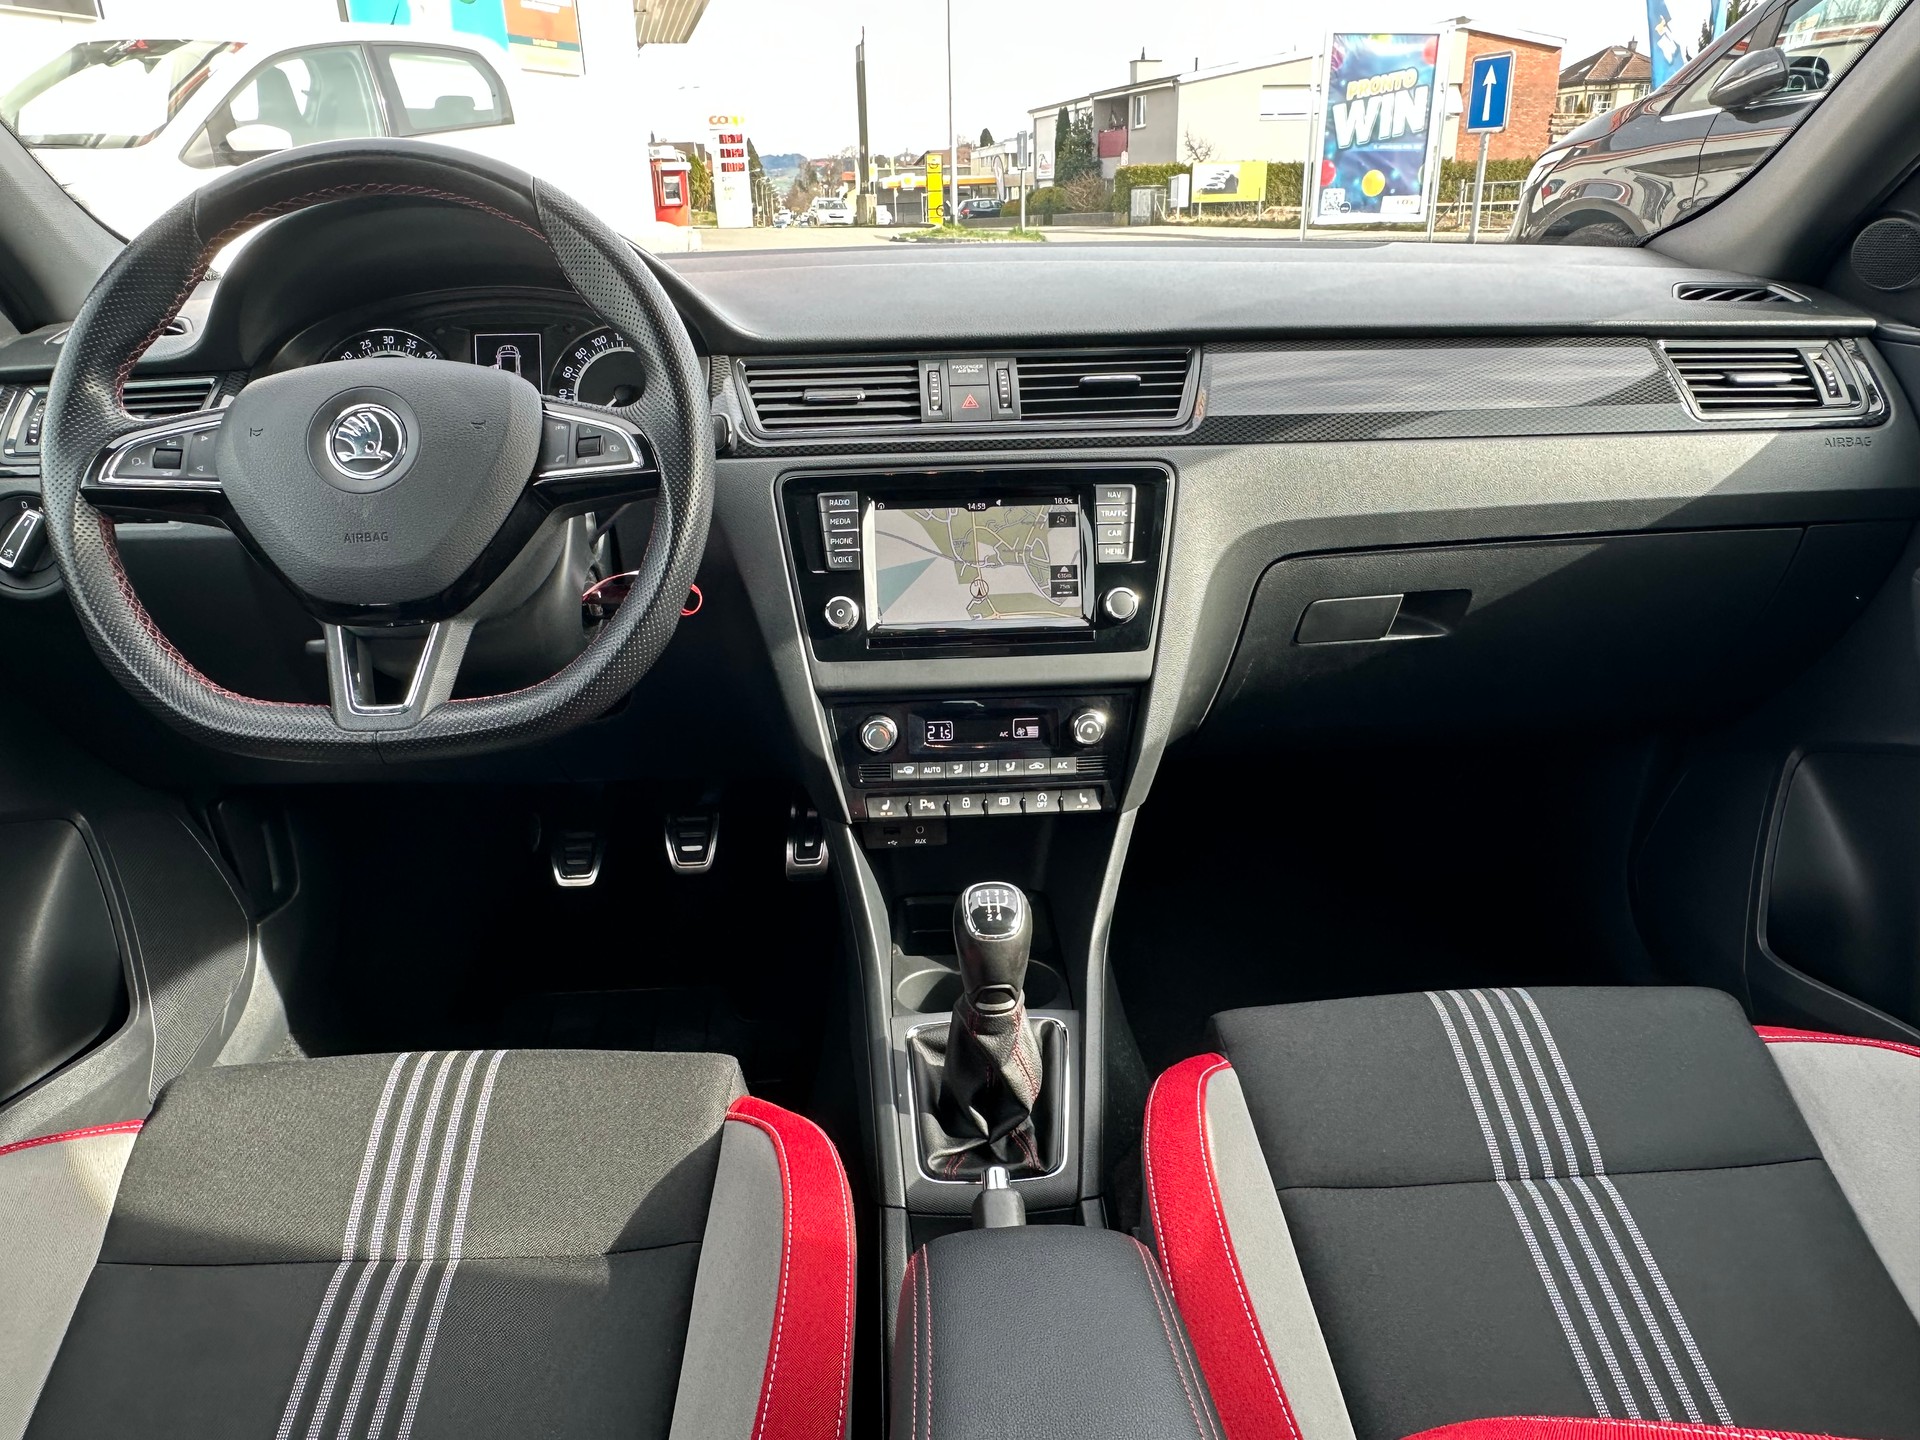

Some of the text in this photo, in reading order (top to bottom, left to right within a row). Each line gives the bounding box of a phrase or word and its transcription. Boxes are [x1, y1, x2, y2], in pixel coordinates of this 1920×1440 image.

[1346, 68, 1418, 100] PRONTO
[1332, 85, 1430, 149] WIN
[360, 339, 372, 350] 25
[382, 335, 395, 345] 30
[405, 338, 418, 349] 35
[425, 350, 438, 360] 40
[562, 366, 574, 379] 60
[574, 347, 587, 360] 80
[591, 335, 607, 347] 100
[1824, 436, 1872, 448] AIRBAG
[1107, 491, 1121, 499] NAV
[829, 499, 851, 507] RADIO
[967, 502, 986, 510] 14:59
[829, 517, 851, 526] MEDIA
[343, 531, 389, 543] AIRBAG
[1107, 529, 1122, 537] CAR
[830, 537, 853, 545] PHONE
[1105, 547, 1125, 555] MENU
[833, 555, 853, 564] VOICE
[923, 766, 941, 774] AUTO
[996, 913, 1002, 921] 4
